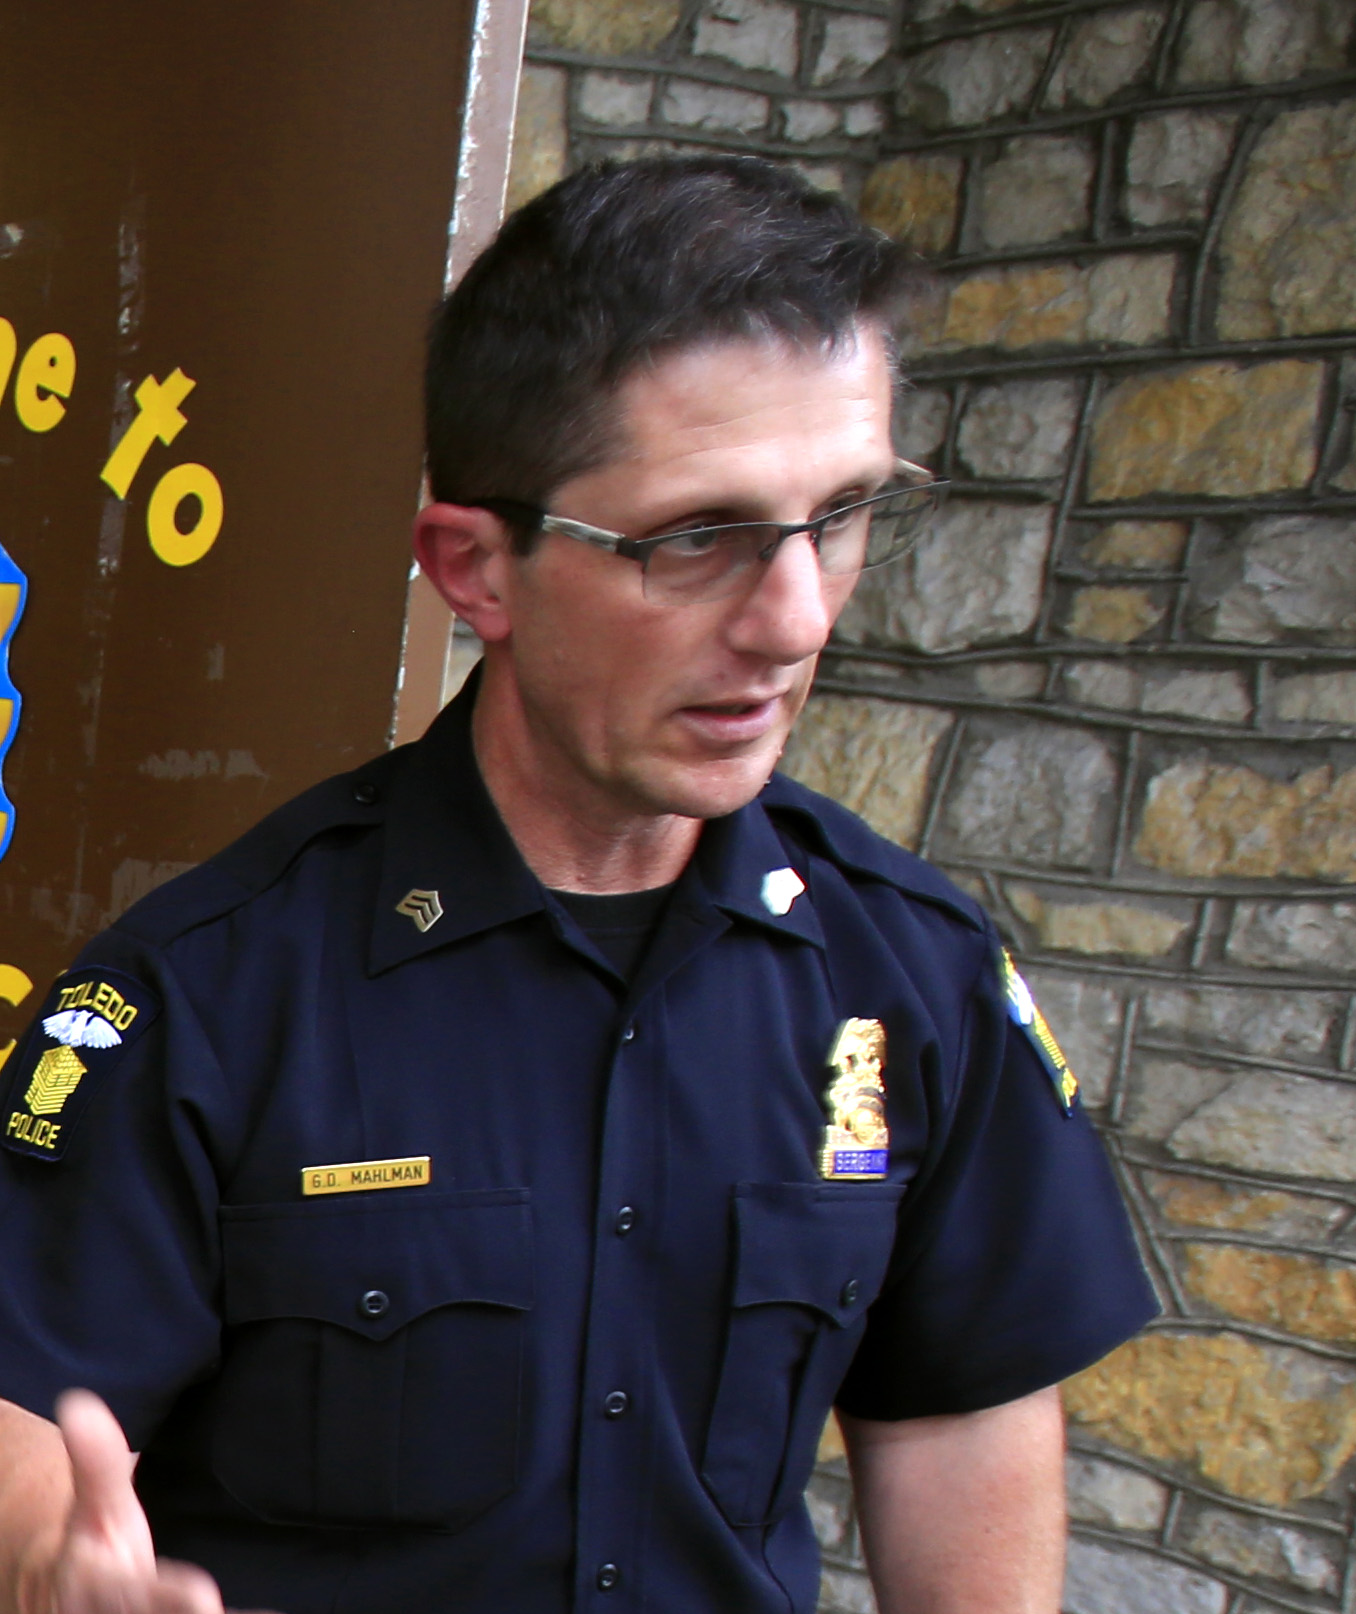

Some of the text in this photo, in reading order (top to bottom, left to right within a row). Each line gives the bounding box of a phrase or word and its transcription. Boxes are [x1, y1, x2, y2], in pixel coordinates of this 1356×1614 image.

[101, 367, 224, 567] to
[56, 981, 138, 1031] TOLEDO
[6, 1112, 62, 1149] POLICE
[351, 1164, 423, 1185] MAHLMAN
